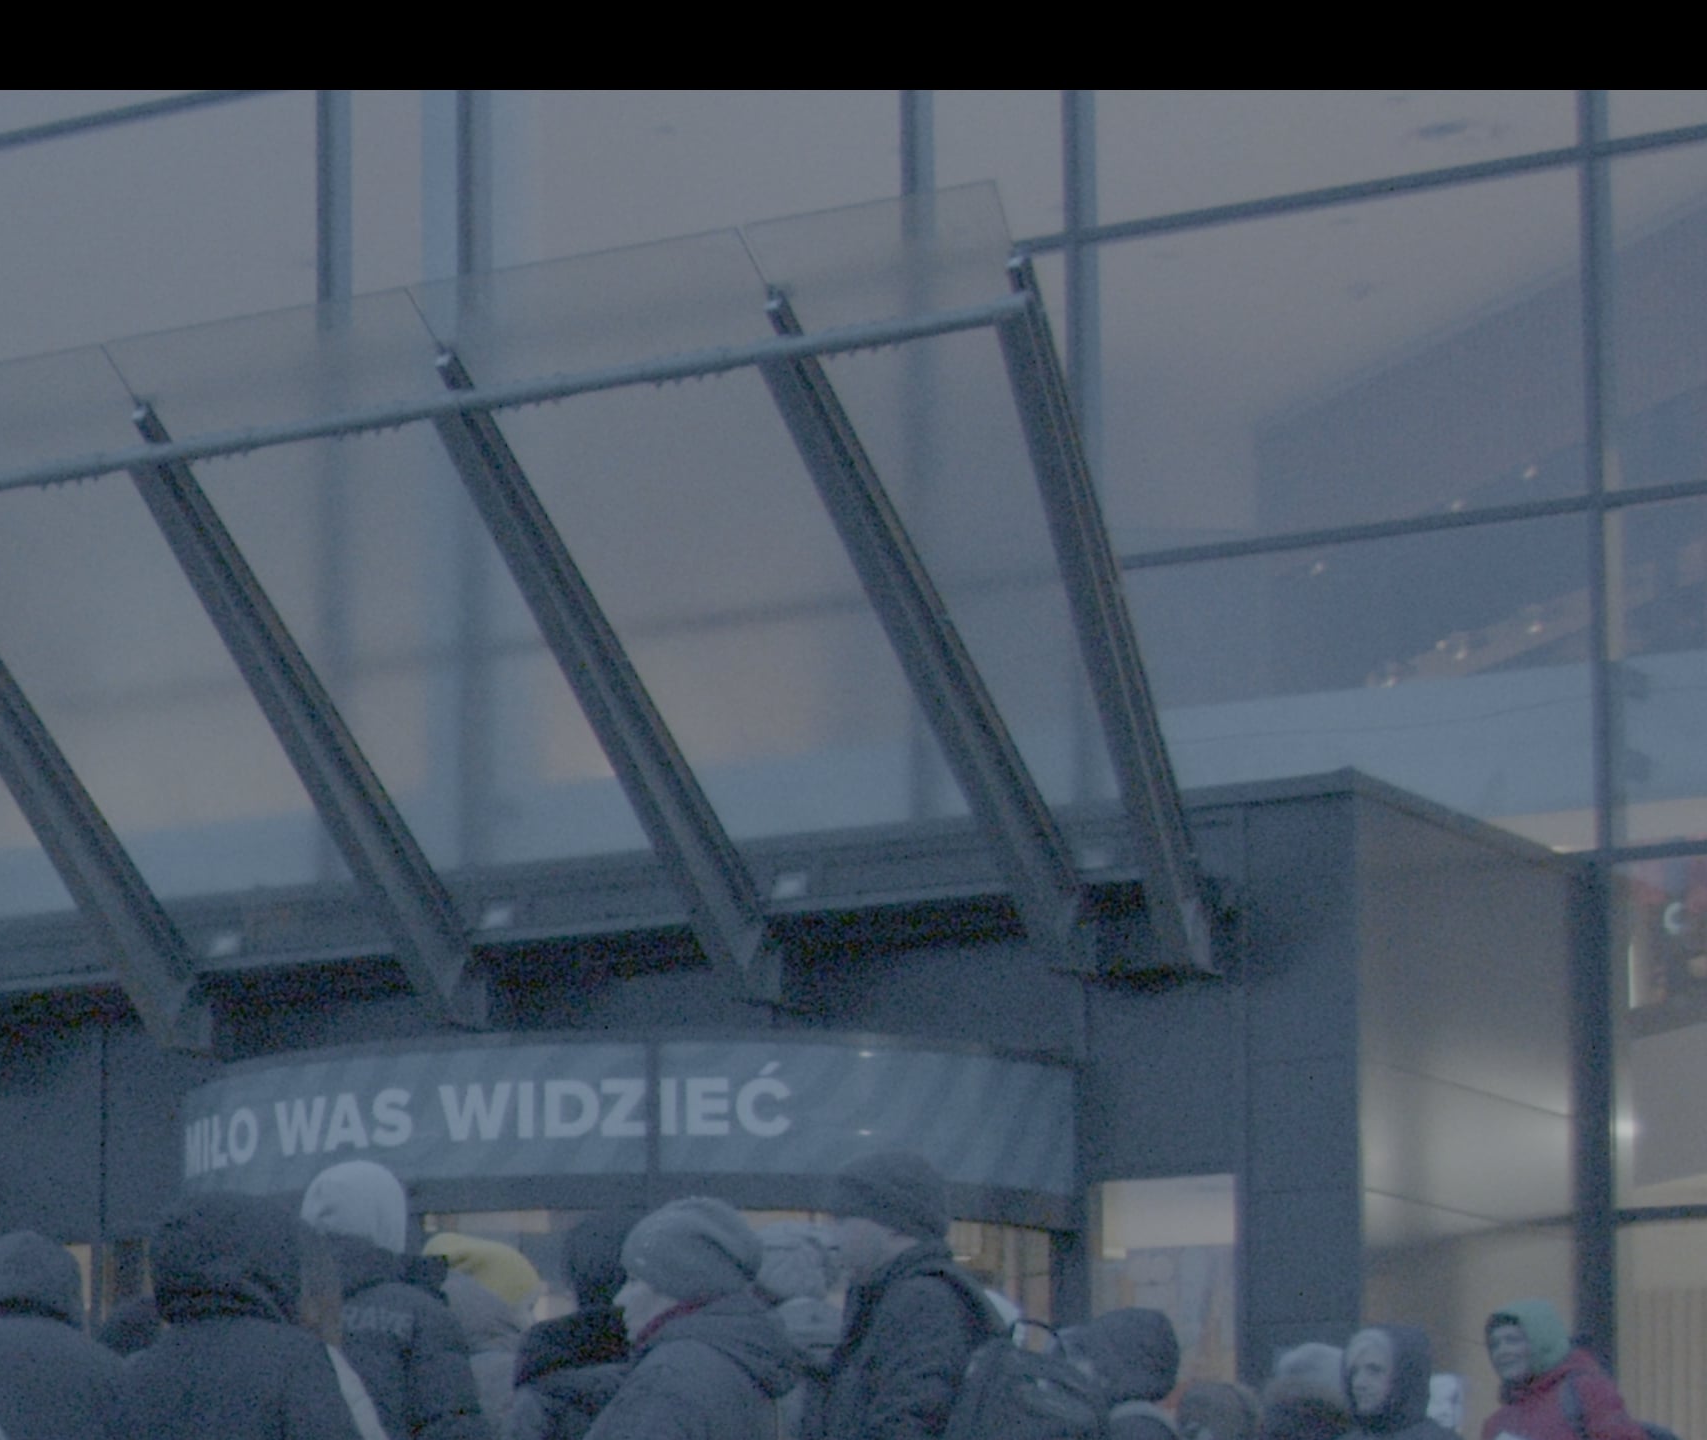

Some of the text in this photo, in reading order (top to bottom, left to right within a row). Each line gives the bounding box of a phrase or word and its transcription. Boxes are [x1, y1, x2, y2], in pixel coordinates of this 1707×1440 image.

[186, 1059, 793, 1176] MIŁO WAS WIDZIEĆ
